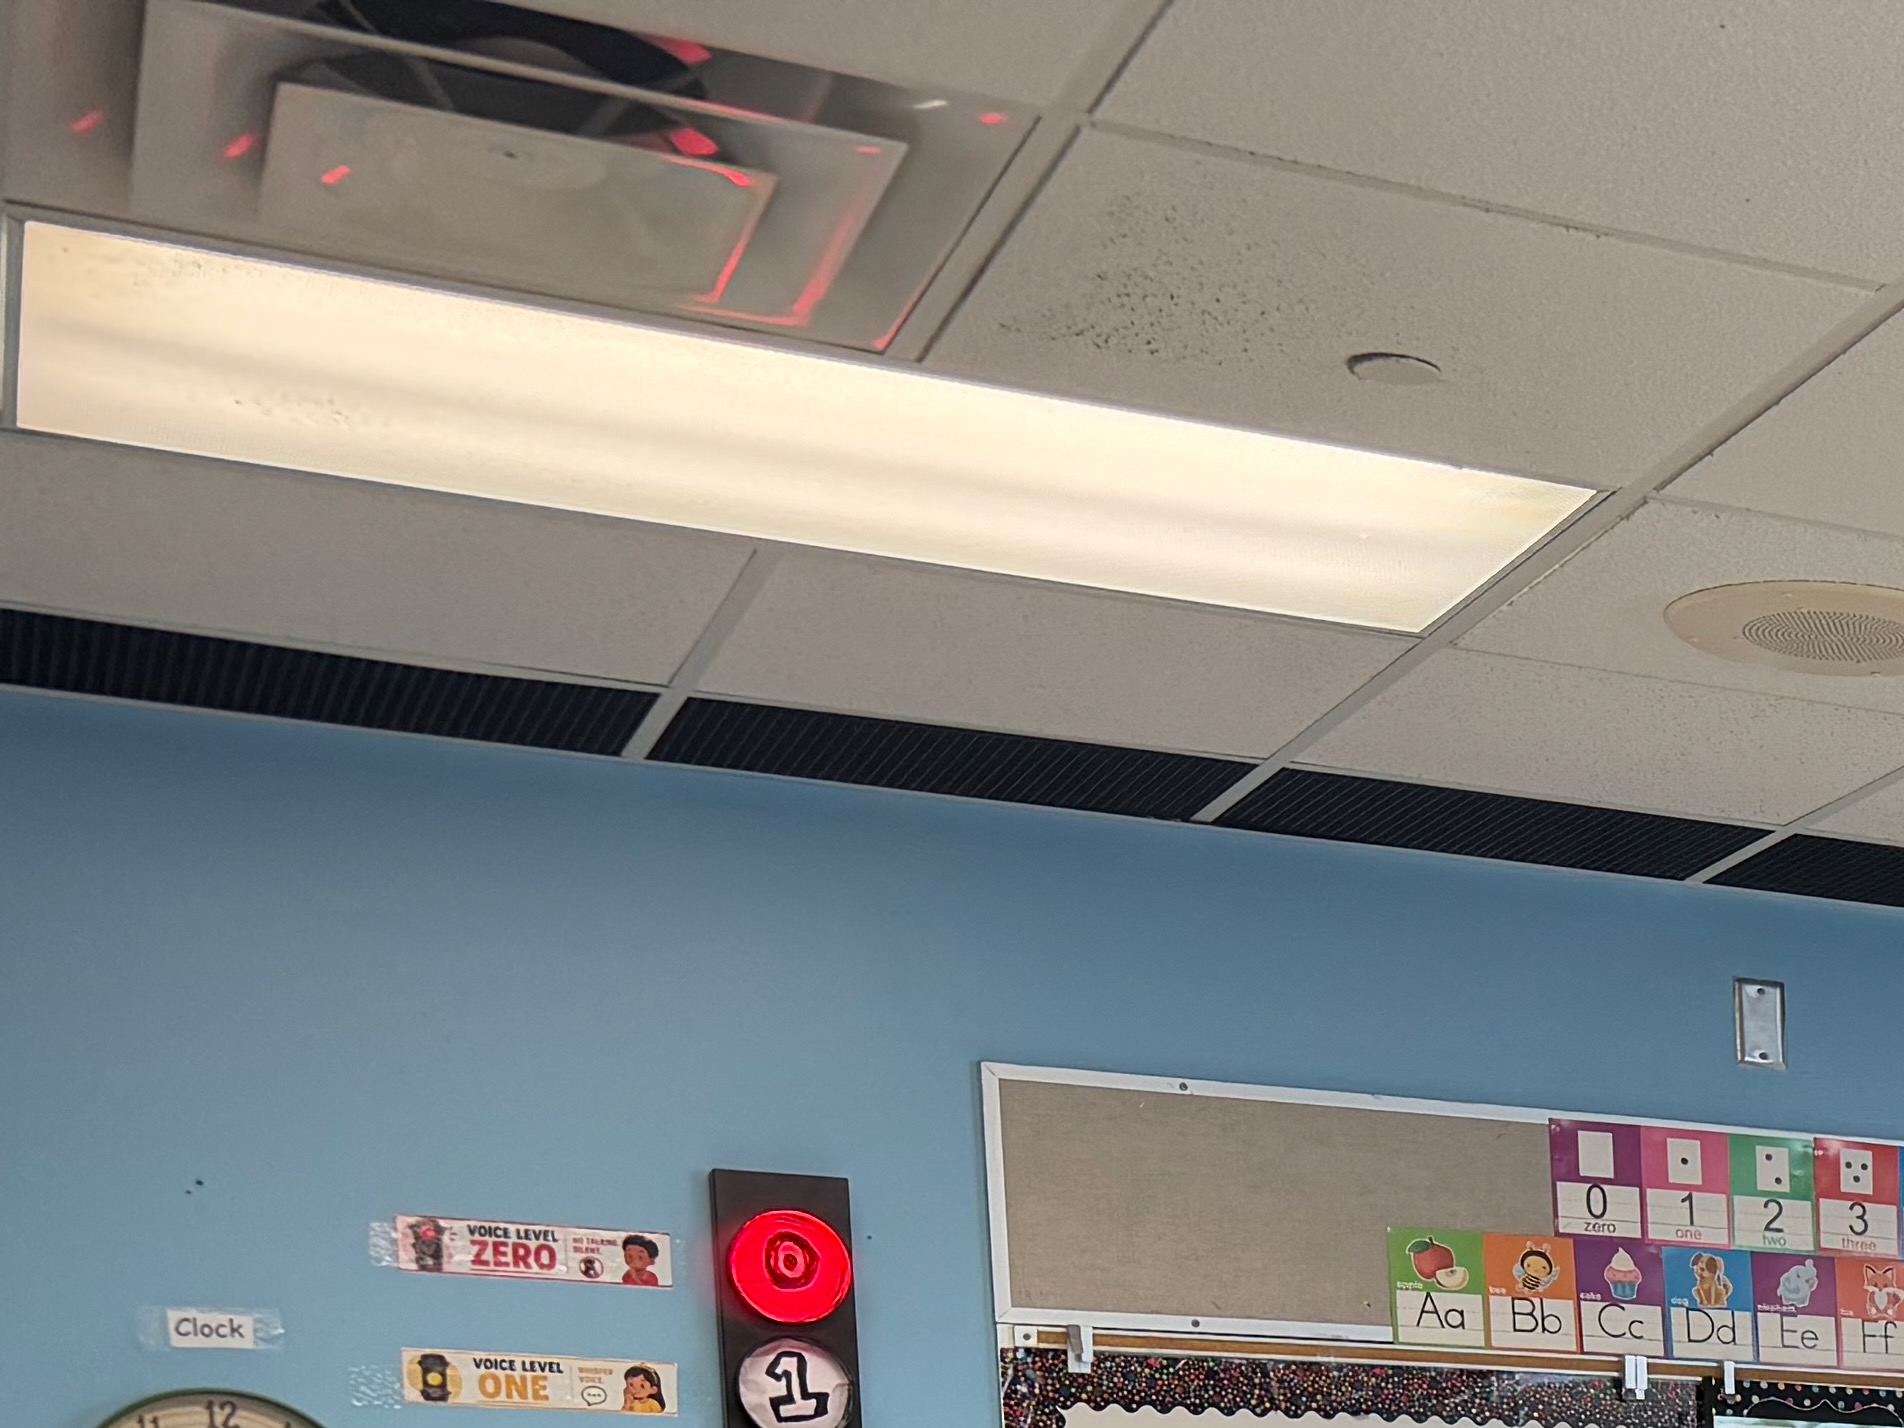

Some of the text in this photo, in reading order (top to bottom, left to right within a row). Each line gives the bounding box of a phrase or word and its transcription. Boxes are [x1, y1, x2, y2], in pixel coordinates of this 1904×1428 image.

[1586, 1184, 1607, 1219] 0
[1681, 1192, 1694, 1224] 1
[1763, 1200, 1784, 1233] 2
[468, 1224, 558, 1242] VOICE LEVEL
[1584, 1220, 1615, 1235] zero
[1848, 1202, 1868, 1235] 3
[470, 1240, 557, 1271] ZERO
[1416, 1292, 1464, 1330] Aa
[1511, 1298, 1561, 1335] Bb
[1599, 1304, 1644, 1340] Cc
[1686, 1310, 1736, 1345] Dd
[174, 1317, 245, 1339] Clock
[473, 1358, 563, 1373] VOICE LEVEL
[478, 1373, 550, 1401] ONE
[768, 1351, 829, 1423] 1
